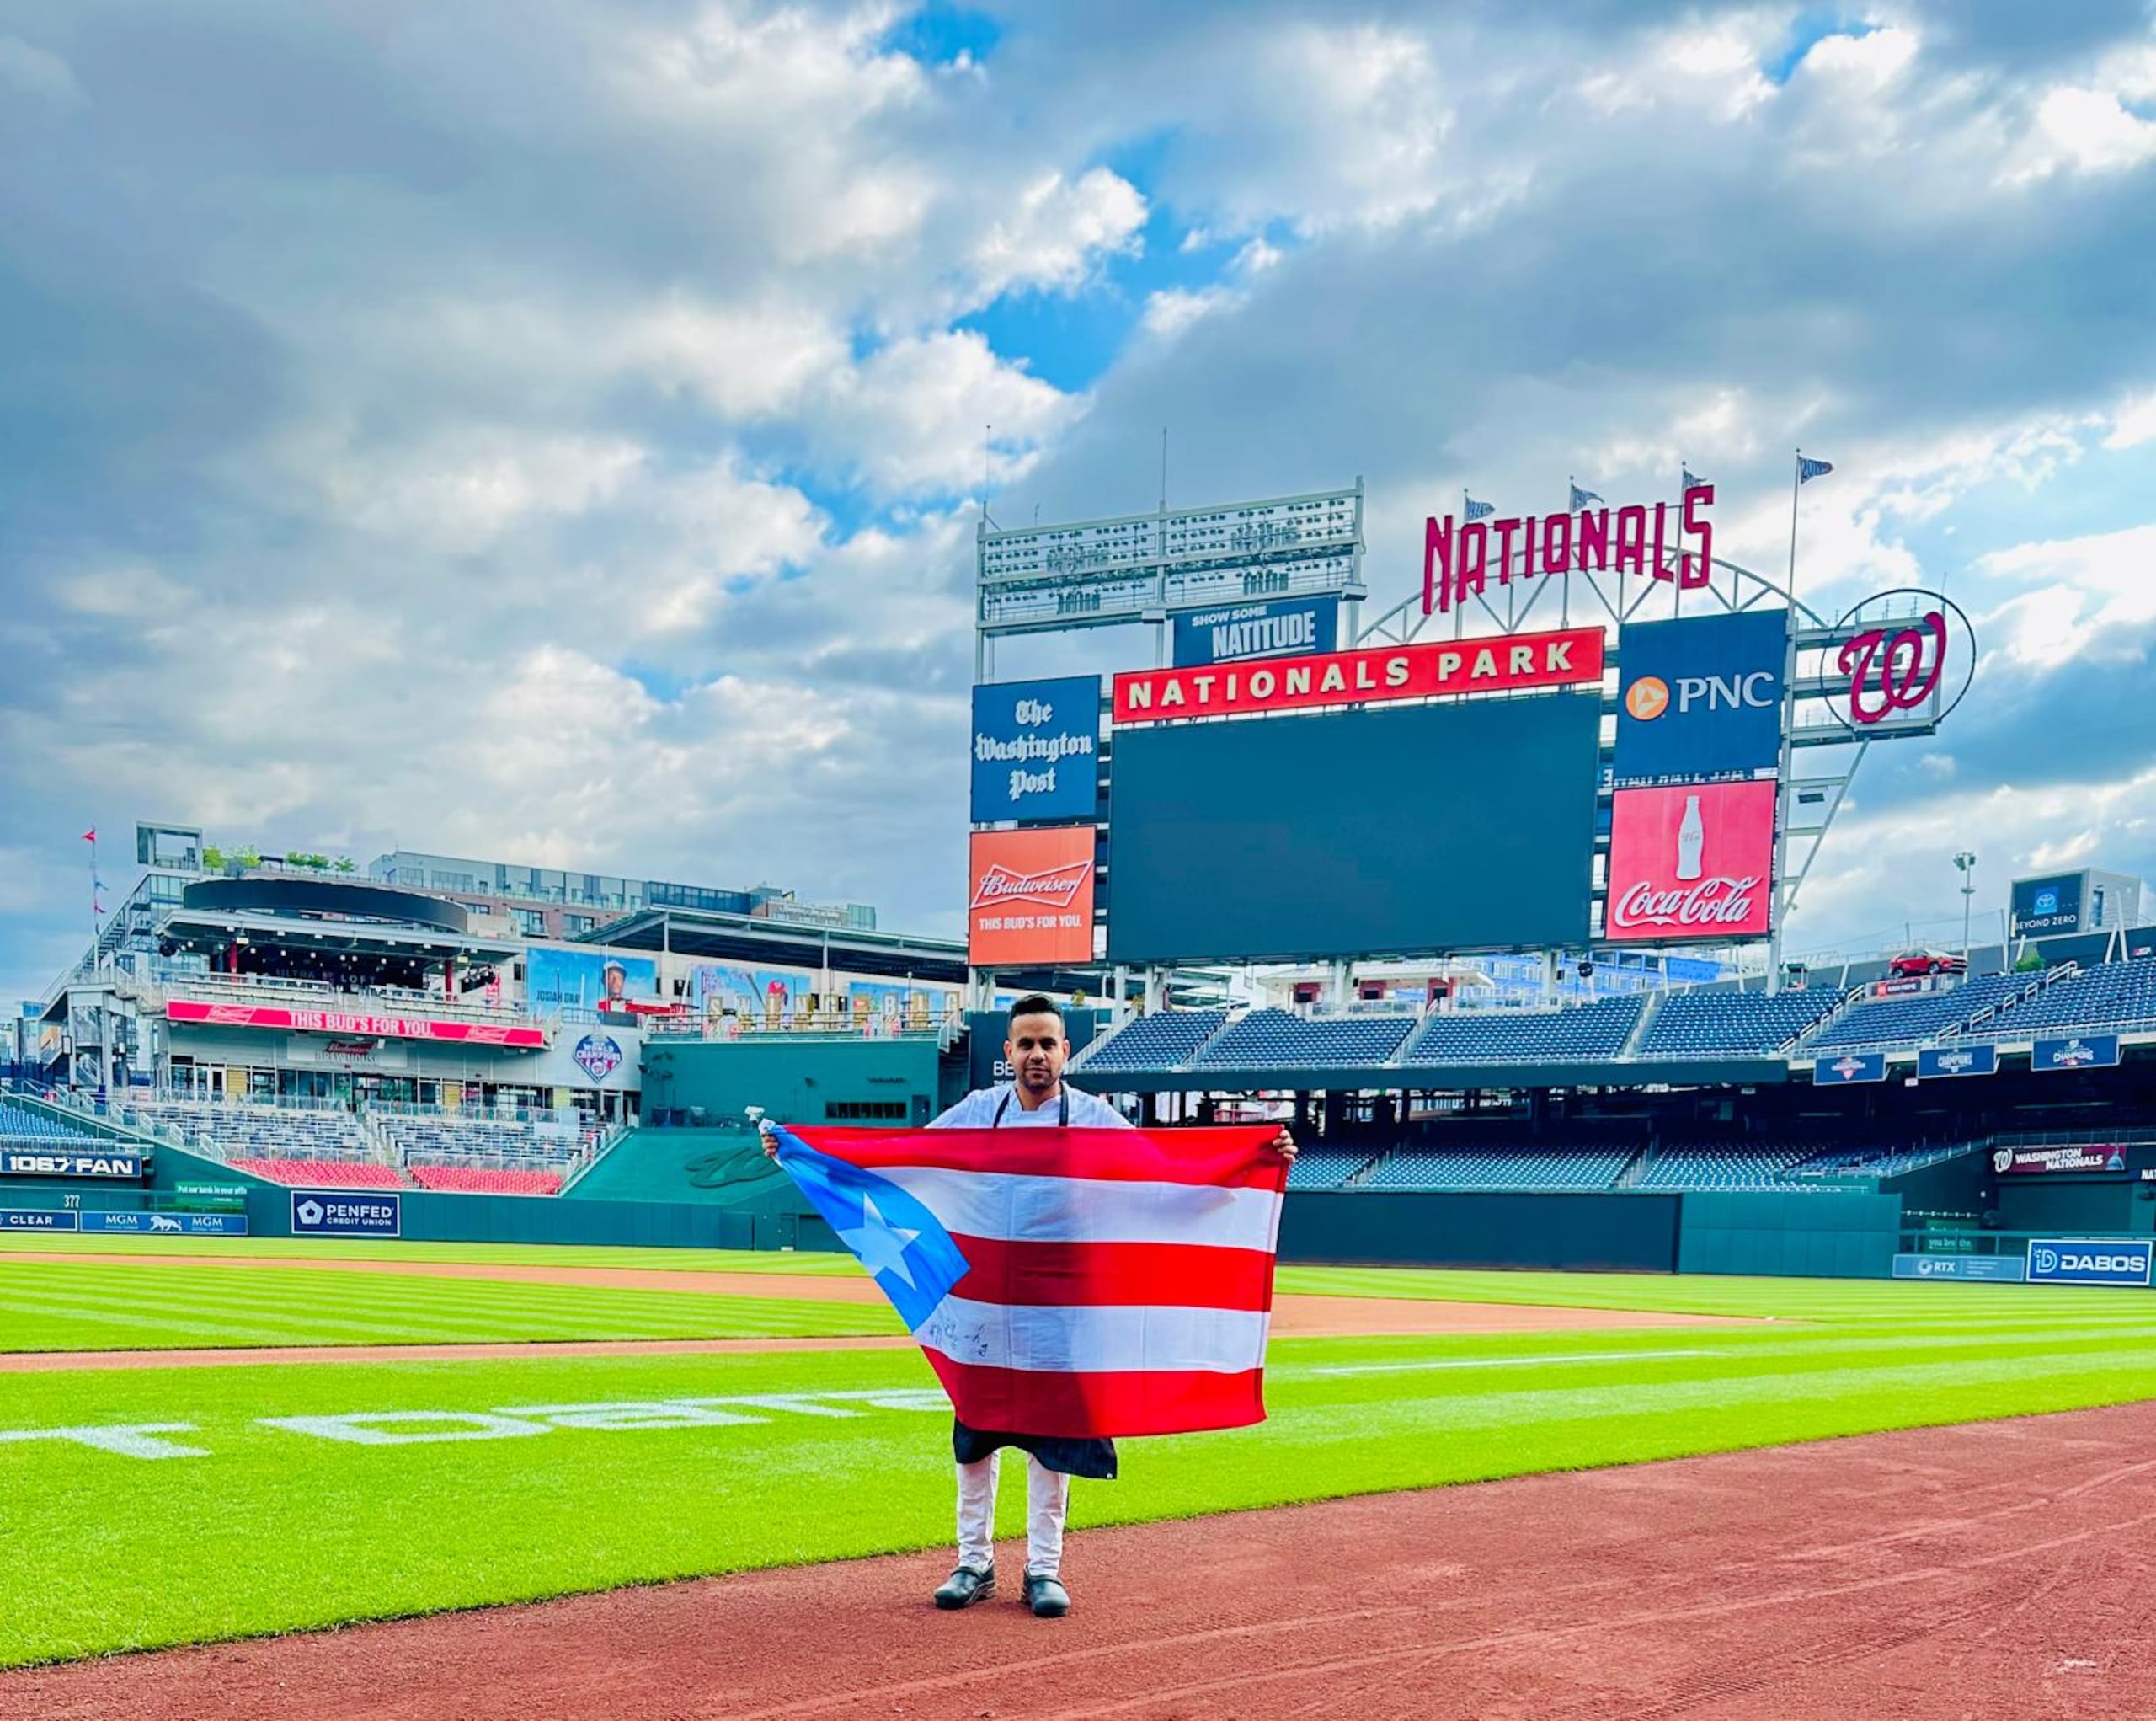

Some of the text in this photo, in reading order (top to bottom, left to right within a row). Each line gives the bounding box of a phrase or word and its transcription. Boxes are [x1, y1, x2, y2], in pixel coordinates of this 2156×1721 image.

[1422, 484, 1714, 616] NATIONALS
[1192, 606, 1267, 627] SHOW SOME
[1212, 611, 1316, 658] NATITUDE
[1128, 641, 1575, 711] NATIONALS PARK
[1676, 672, 1774, 713] PNC
[1014, 698, 1053, 727] The
[974, 730, 1093, 762] Washington
[1009, 767, 1057, 800] Post
[980, 874, 1079, 896] Budweiser
[979, 914, 1082, 931] THIS BUD'S FOR YOU.
[2016, 913, 2078, 931] EYOND ZERO
[340, 974, 376, 984] LOFT
[536, 990, 563, 1003] JOSIAH
[290, 1011, 435, 1037] THIS BUD'S FOR YOU.
[2015, 1147, 2083, 1165] WASHINGTON
[2045, 1154, 2103, 1171] NATIONALS
[77, 1158, 133, 1174] FAN
[64, 1195, 80, 1208] 377
[327, 1204, 392, 1218] PENFED
[9, 1215, 53, 1226] CLEAR
[106, 1215, 138, 1225] MGM
[192, 1216, 223, 1227] MGM
[327, 1216, 392, 1227] CREDIT UNION
[1929, 1239, 1942, 1250] you
[1934, 1262, 1956, 1272] RTX
[2060, 1254, 2146, 1272] DABOS
